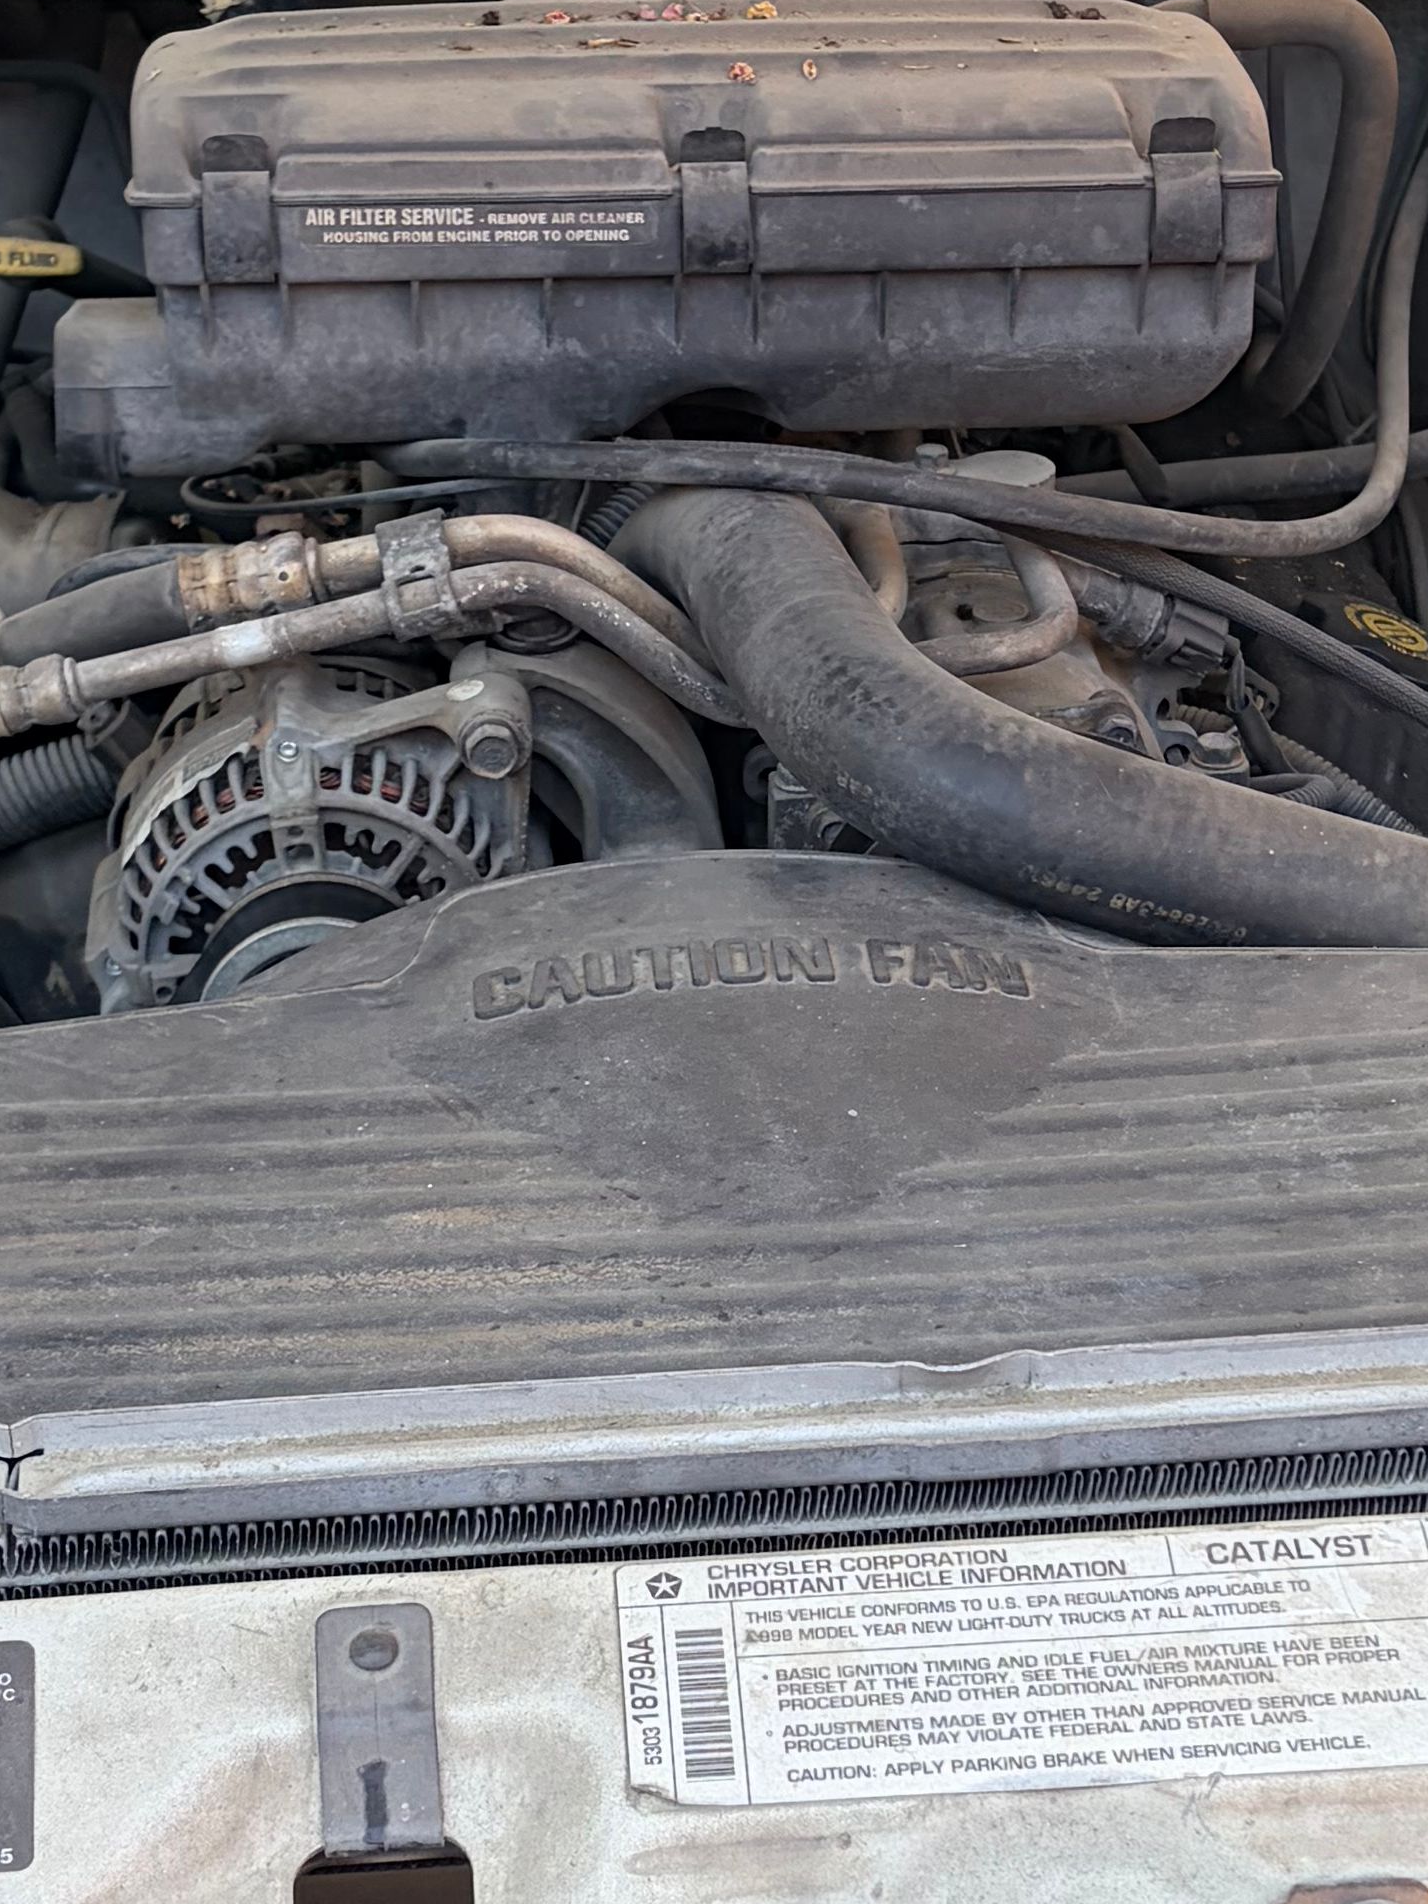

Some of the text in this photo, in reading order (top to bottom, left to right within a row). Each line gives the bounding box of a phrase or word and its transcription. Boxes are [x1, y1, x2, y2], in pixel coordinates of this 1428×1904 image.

[305, 208, 475, 225] AIR FILTER SERVICE
[323, 229, 630, 242] HOUSING FROM ENGINE PRIOR TO OPENING
[487, 212, 645, 224] REMOVE AIR CLEANER
[472, 937, 1033, 1019] CAUTION FAN
[706, 1548, 1008, 1580] CHRYSLER CORPORATION
[1204, 1534, 1376, 1564] CATALYST
[707, 1559, 1126, 1599] IMPORTANT VEHICLE INFORMATION
[745, 1579, 1311, 1624] THIS VEHICLE CONFORMS TO U.S. EPA REGULATIONS APPLICABLE TO
[798, 1600, 1286, 1640] MODEL YEAR NEW LIGHT-DUTY TRUCKS AT ALL ALTITUDES.
[775, 1634, 1380, 1681] BASIC IGNITION TIMING AND IDLE FUEL/AIR MIXTURE HAVE BEEN
[776, 1680, 848, 1696] PRESET
[852, 1678, 878, 1691] AT
[882, 1676, 918, 1690] THE
[1020, 1668, 1056, 1682] SEE
[1061, 1666, 1098, 1680] THE
[1103, 1660, 1189, 1677] OWNERS
[1193, 1655, 1277, 1672] MANUAL
[1282, 1652, 1320, 1667] FOR
[1324, 1648, 1400, 1664] PROPER
[778, 1670, 1279, 1711] PROCEDURES AND OTHER ADDITIONAL INFORMATION.
[781, 1687, 1427, 1738] ADJUSTMENTS MADE BY OTHER THAN APPROVED SERVICE MANUAL
[784, 1709, 1312, 1753] PROCEDURES MAY VIOLATE FEDERAL AND STATE LAWS.
[786, 1764, 876, 1782] CAUTION:
[883, 1760, 945, 1777] APPLY
[950, 1754, 1037, 1773] PARKING
[1042, 1750, 1107, 1768] BRAKE
[1112, 1746, 1175, 1763] WHEN
[1180, 1740, 1282, 1758] SERVICING
